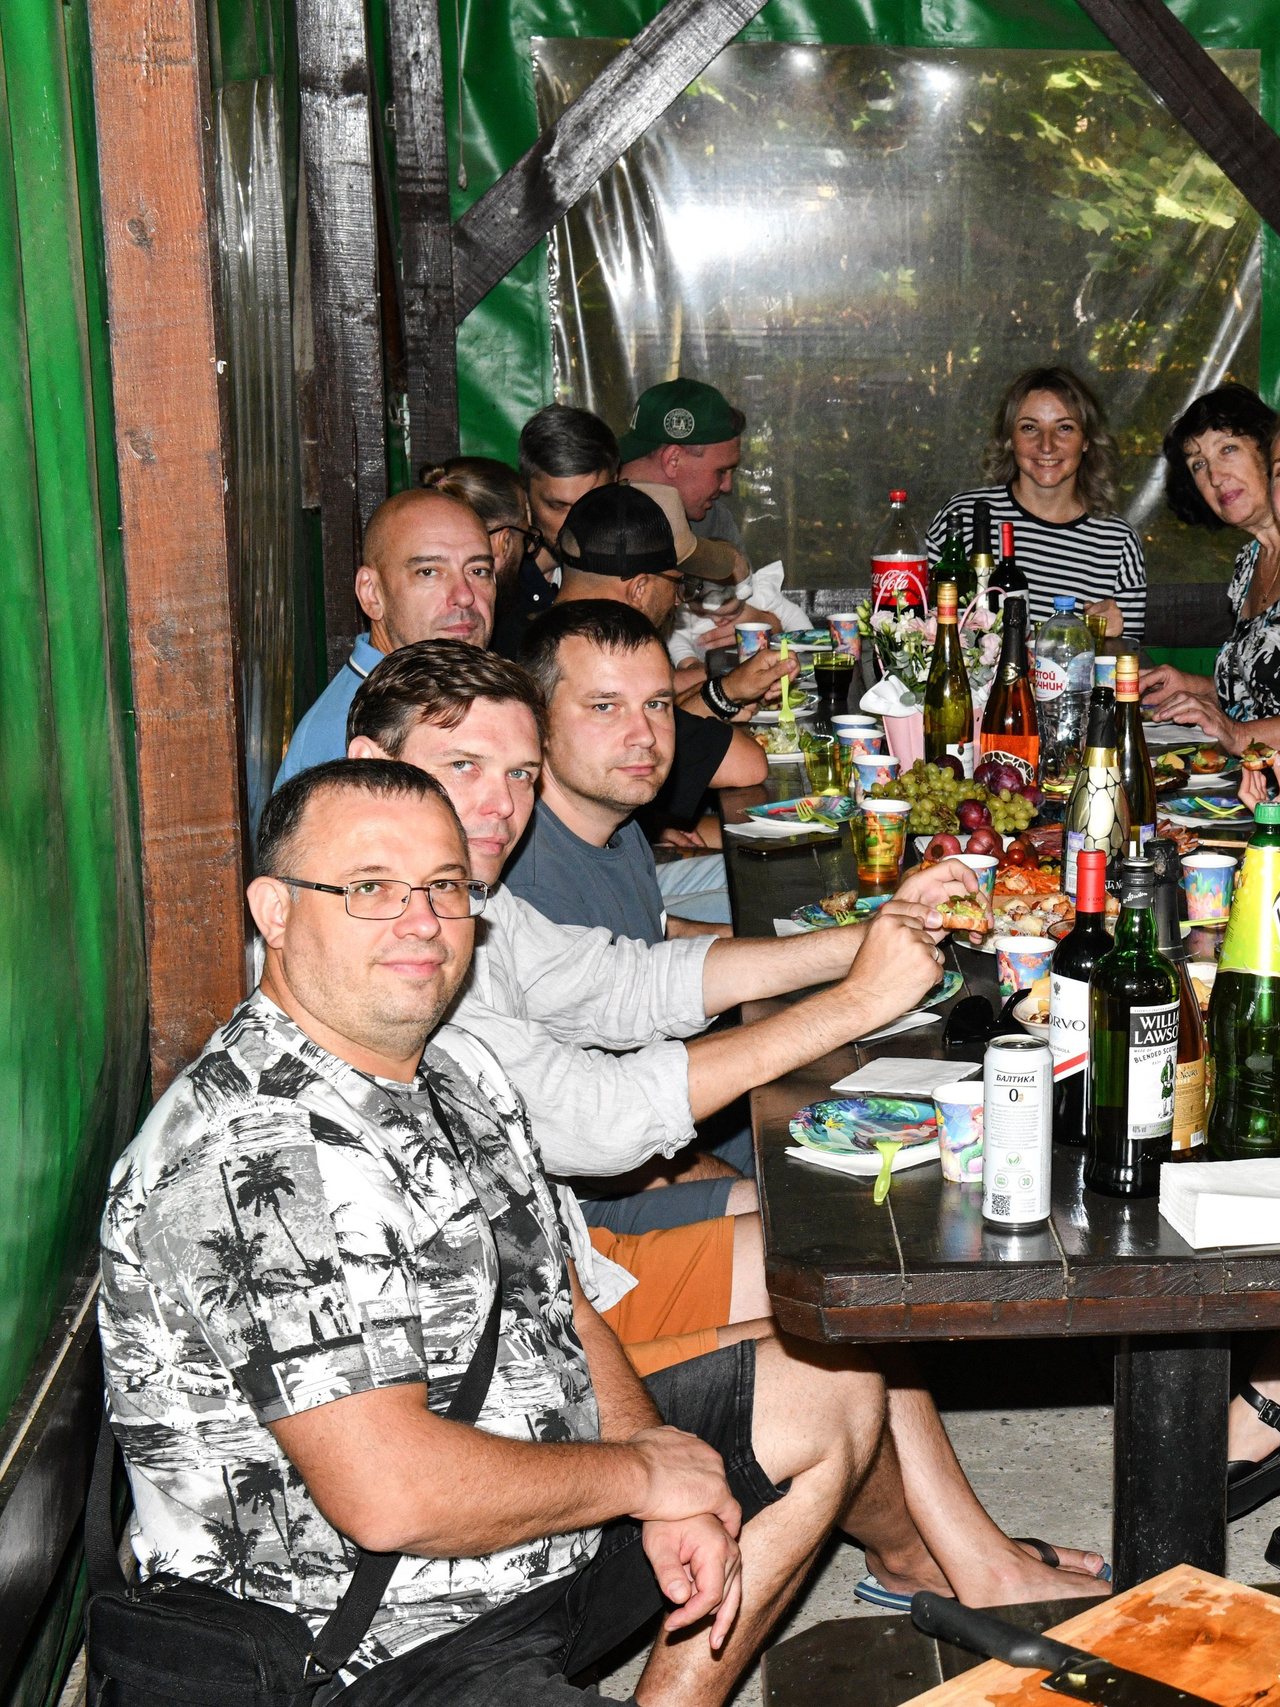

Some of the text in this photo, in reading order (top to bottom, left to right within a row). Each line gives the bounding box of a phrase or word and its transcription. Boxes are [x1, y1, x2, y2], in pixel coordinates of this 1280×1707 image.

[1036, 681, 1063, 690] ЧНИК
[1049, 1012, 1086, 1031] ORVO
[1134, 1025, 1178, 1044] LAWSO
[1134, 1050, 1162, 1063] BLENDED
[996, 1074, 1035, 1083] БАЛТИКА
[1008, 1088, 1019, 1102] 0
